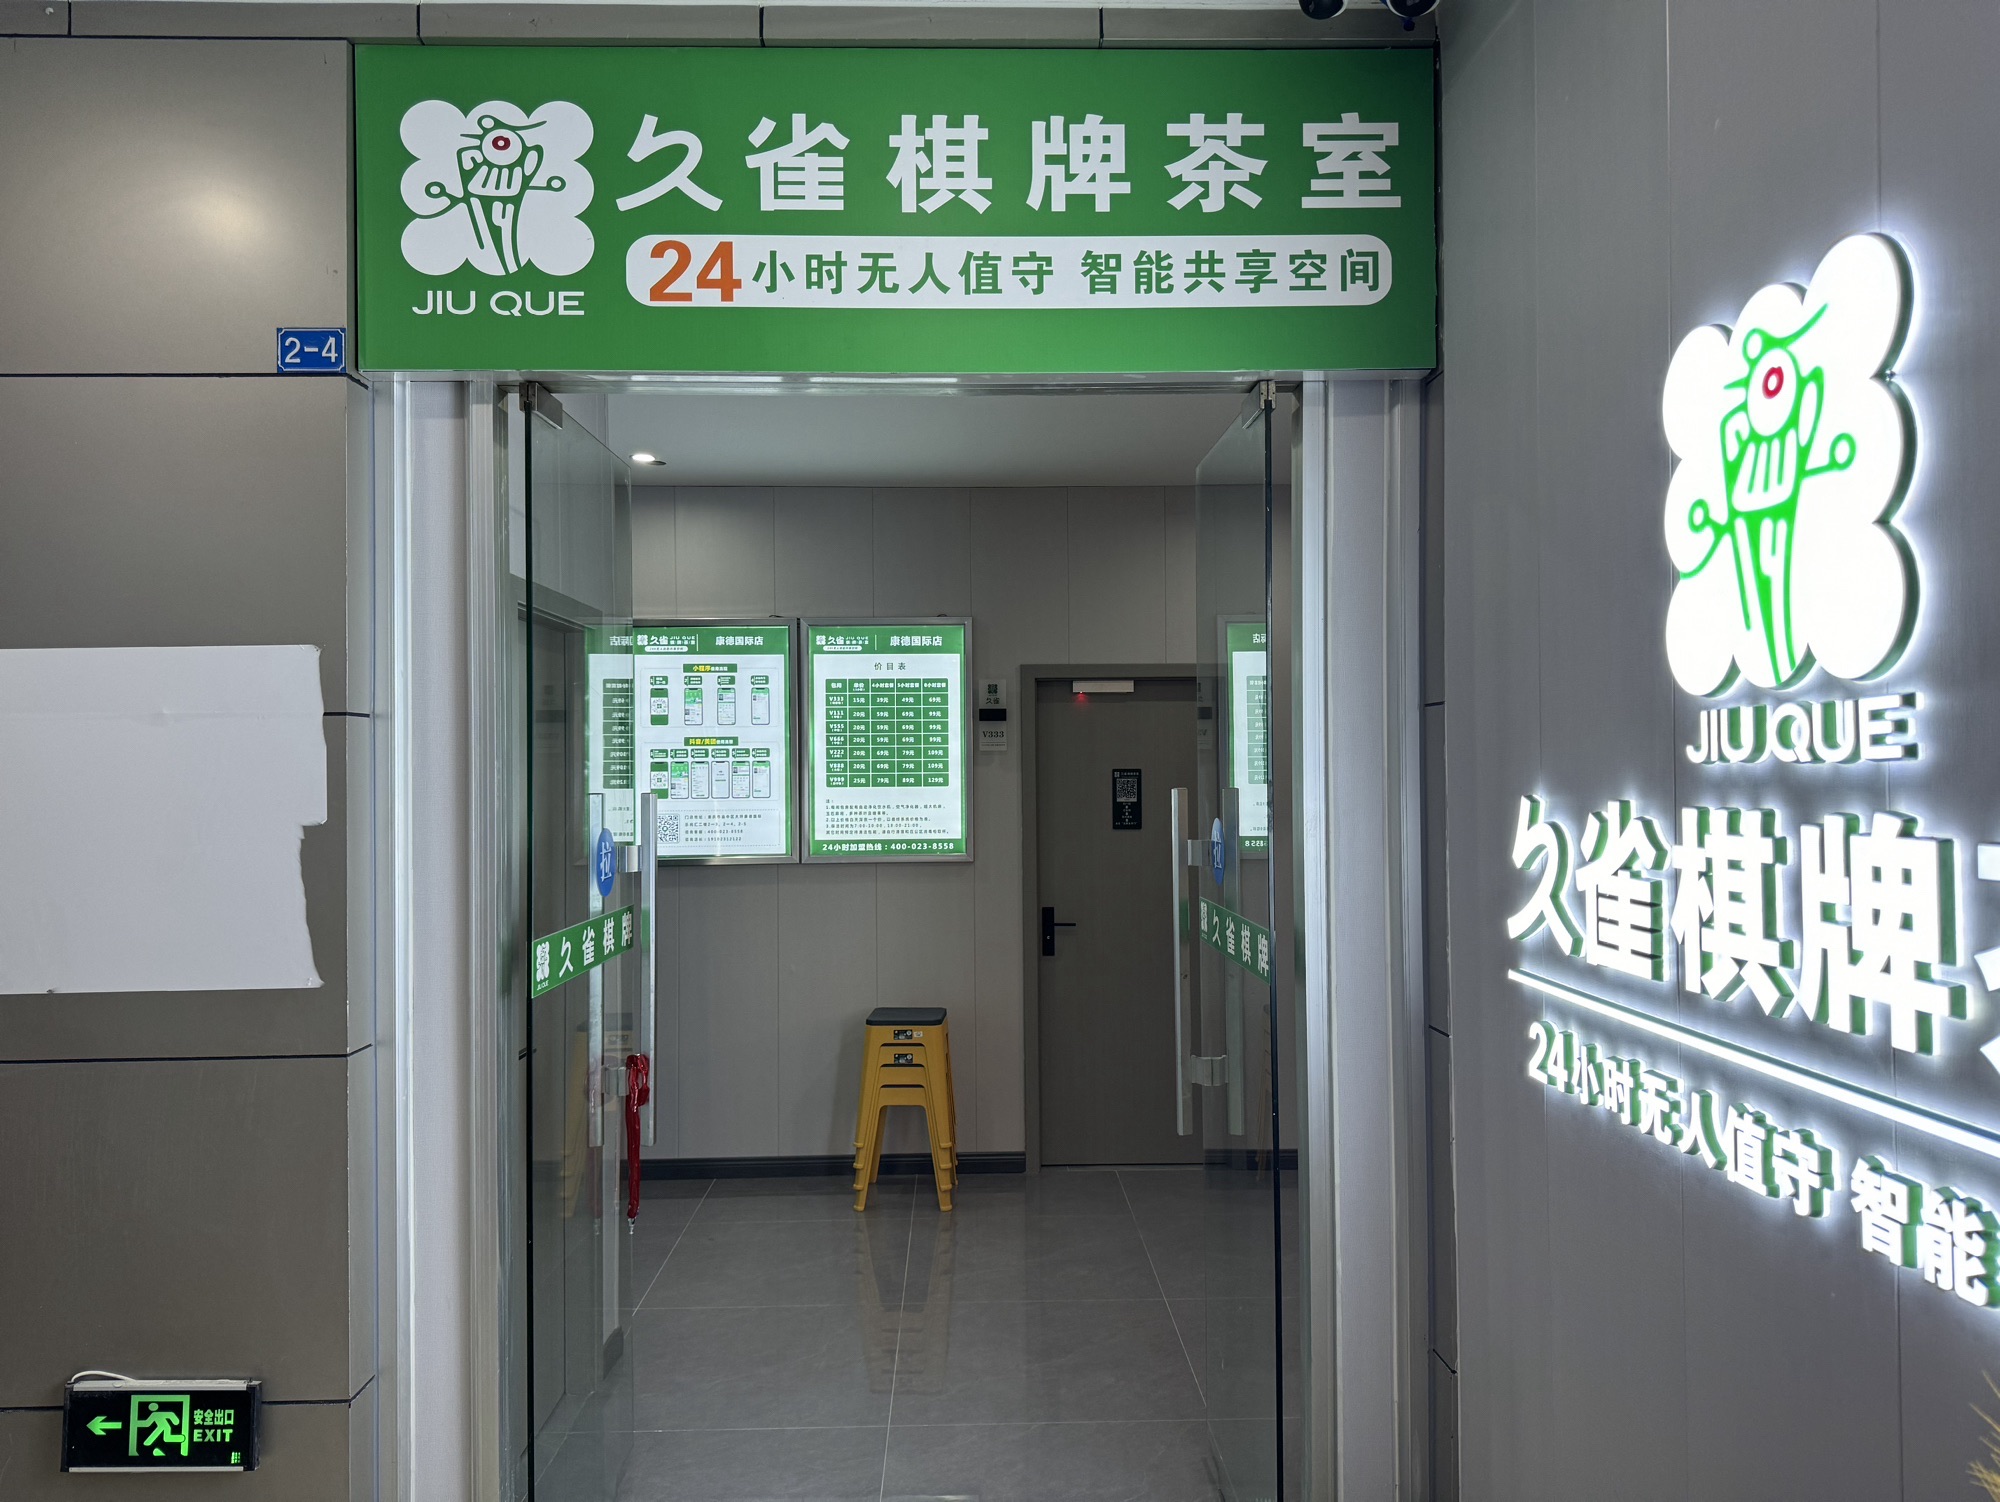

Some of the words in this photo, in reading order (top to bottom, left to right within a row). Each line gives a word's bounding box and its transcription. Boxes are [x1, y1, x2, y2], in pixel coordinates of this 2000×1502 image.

[616, 112, 1402, 215] 久雀棋牌茶室
[649, 239, 1056, 304] 24小时无人值守
[1080, 248, 1382, 294] 智能共享空间
[411, 290, 478, 316] JIU
[490, 290, 585, 316] QUE
[284, 336, 338, 363] 2-4
[716, 636, 764, 646] 康德国际店
[890, 635, 943, 646] 康德国际店
[874, 662, 906, 671] 价目表
[982, 730, 1004, 738] V333
[600, 842, 612, 882] 拉
[559, 911, 632, 978] 久雀棋牌
[1212, 909, 1269, 977] 久雀棋牌
[1507, 794, 2000, 1076] 久雀棋牌
[1527, 1021, 1838, 1217] 24小时无人值守
[193, 1408, 234, 1426] 安全出口
[193, 1429, 234, 1442] EXIT
